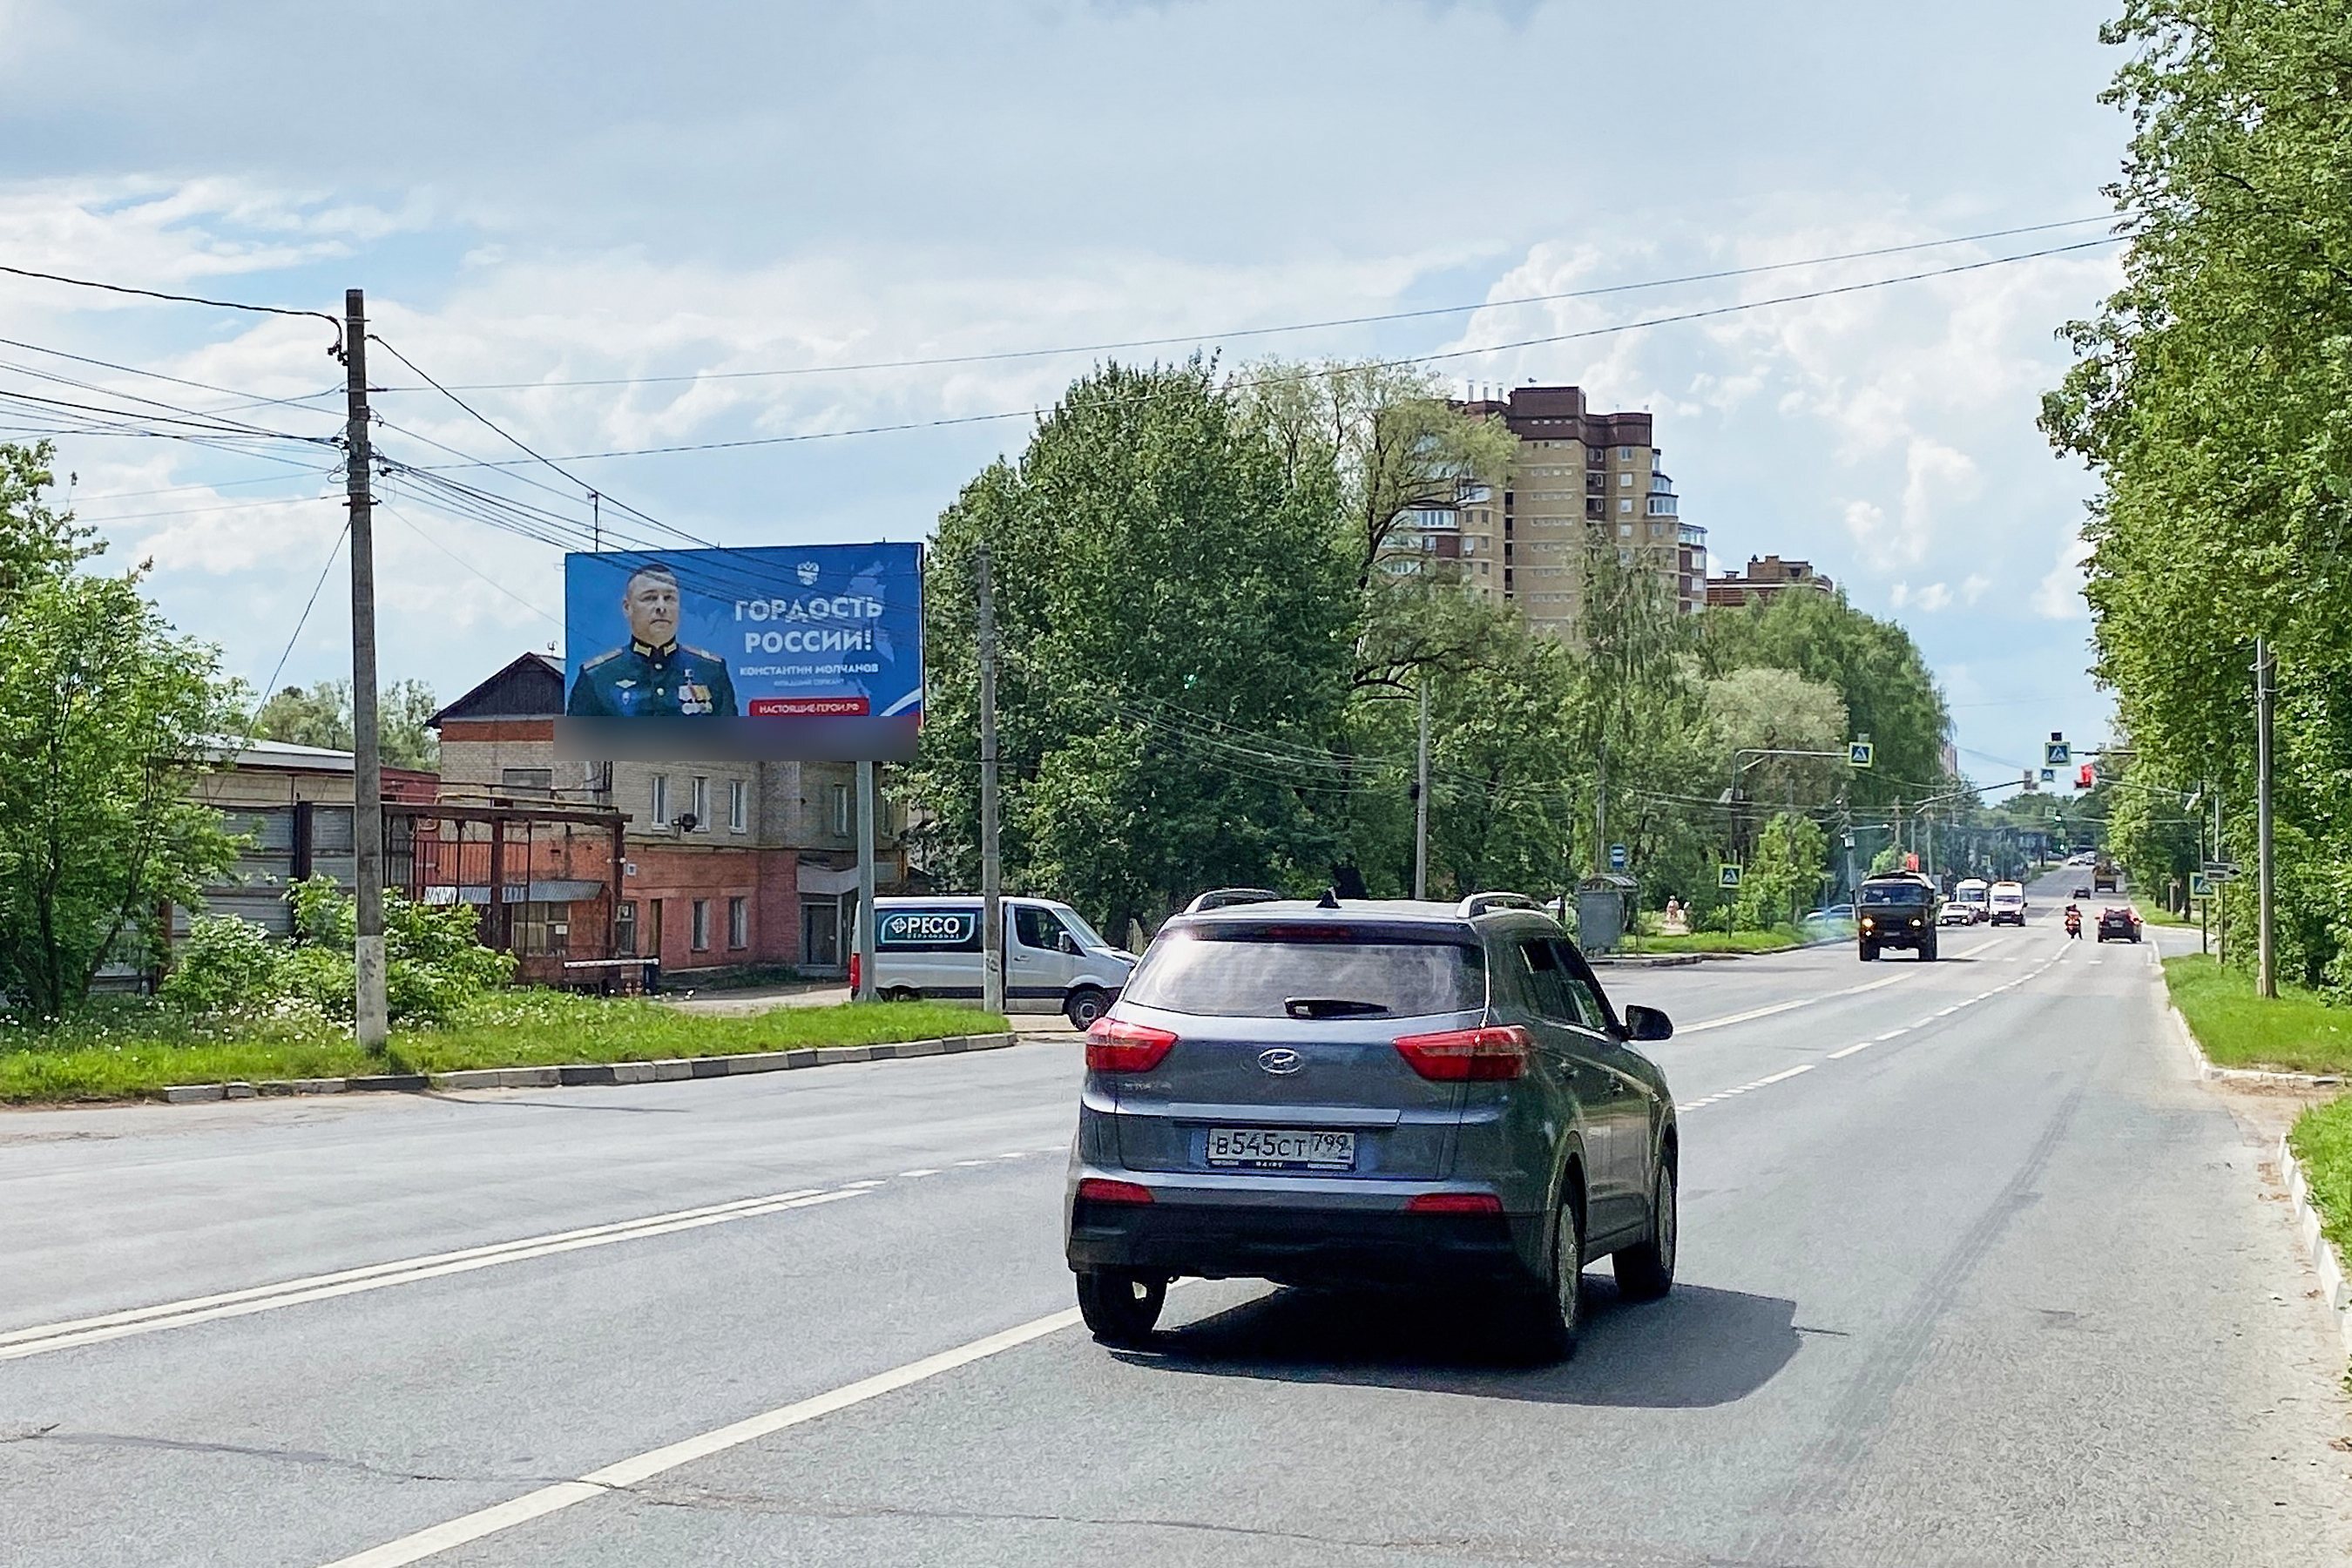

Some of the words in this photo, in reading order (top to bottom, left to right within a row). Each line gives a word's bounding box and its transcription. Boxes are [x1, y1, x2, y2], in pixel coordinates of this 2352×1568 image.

[734, 597, 883, 623] ГОРДОСТЬ
[745, 629, 872, 653] РОССИИ!
[740, 665, 813, 676] КОНСТАНТИН
[815, 663, 879, 674] МОЛЧАНОВ
